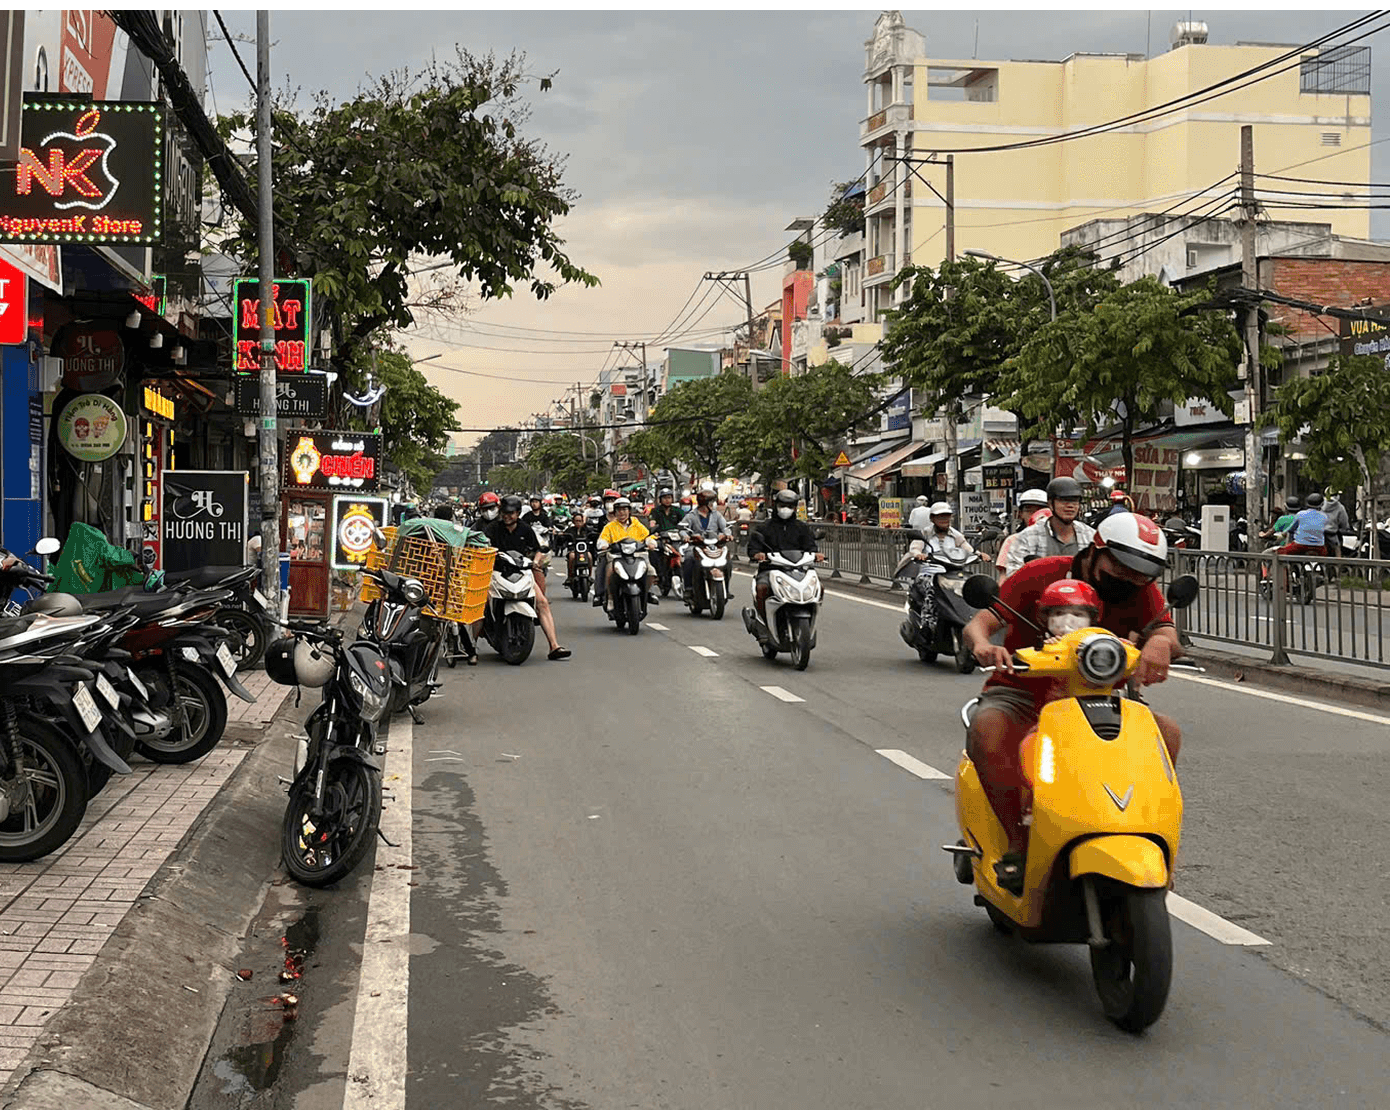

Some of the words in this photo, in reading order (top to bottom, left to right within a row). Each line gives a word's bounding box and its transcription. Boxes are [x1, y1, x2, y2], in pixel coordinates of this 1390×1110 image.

[92, 215, 143, 234] Store
[1162, 448, 1178, 464] XE
[165, 520, 214, 540] HƯƠNG
[219, 521, 241, 543] THỊ
